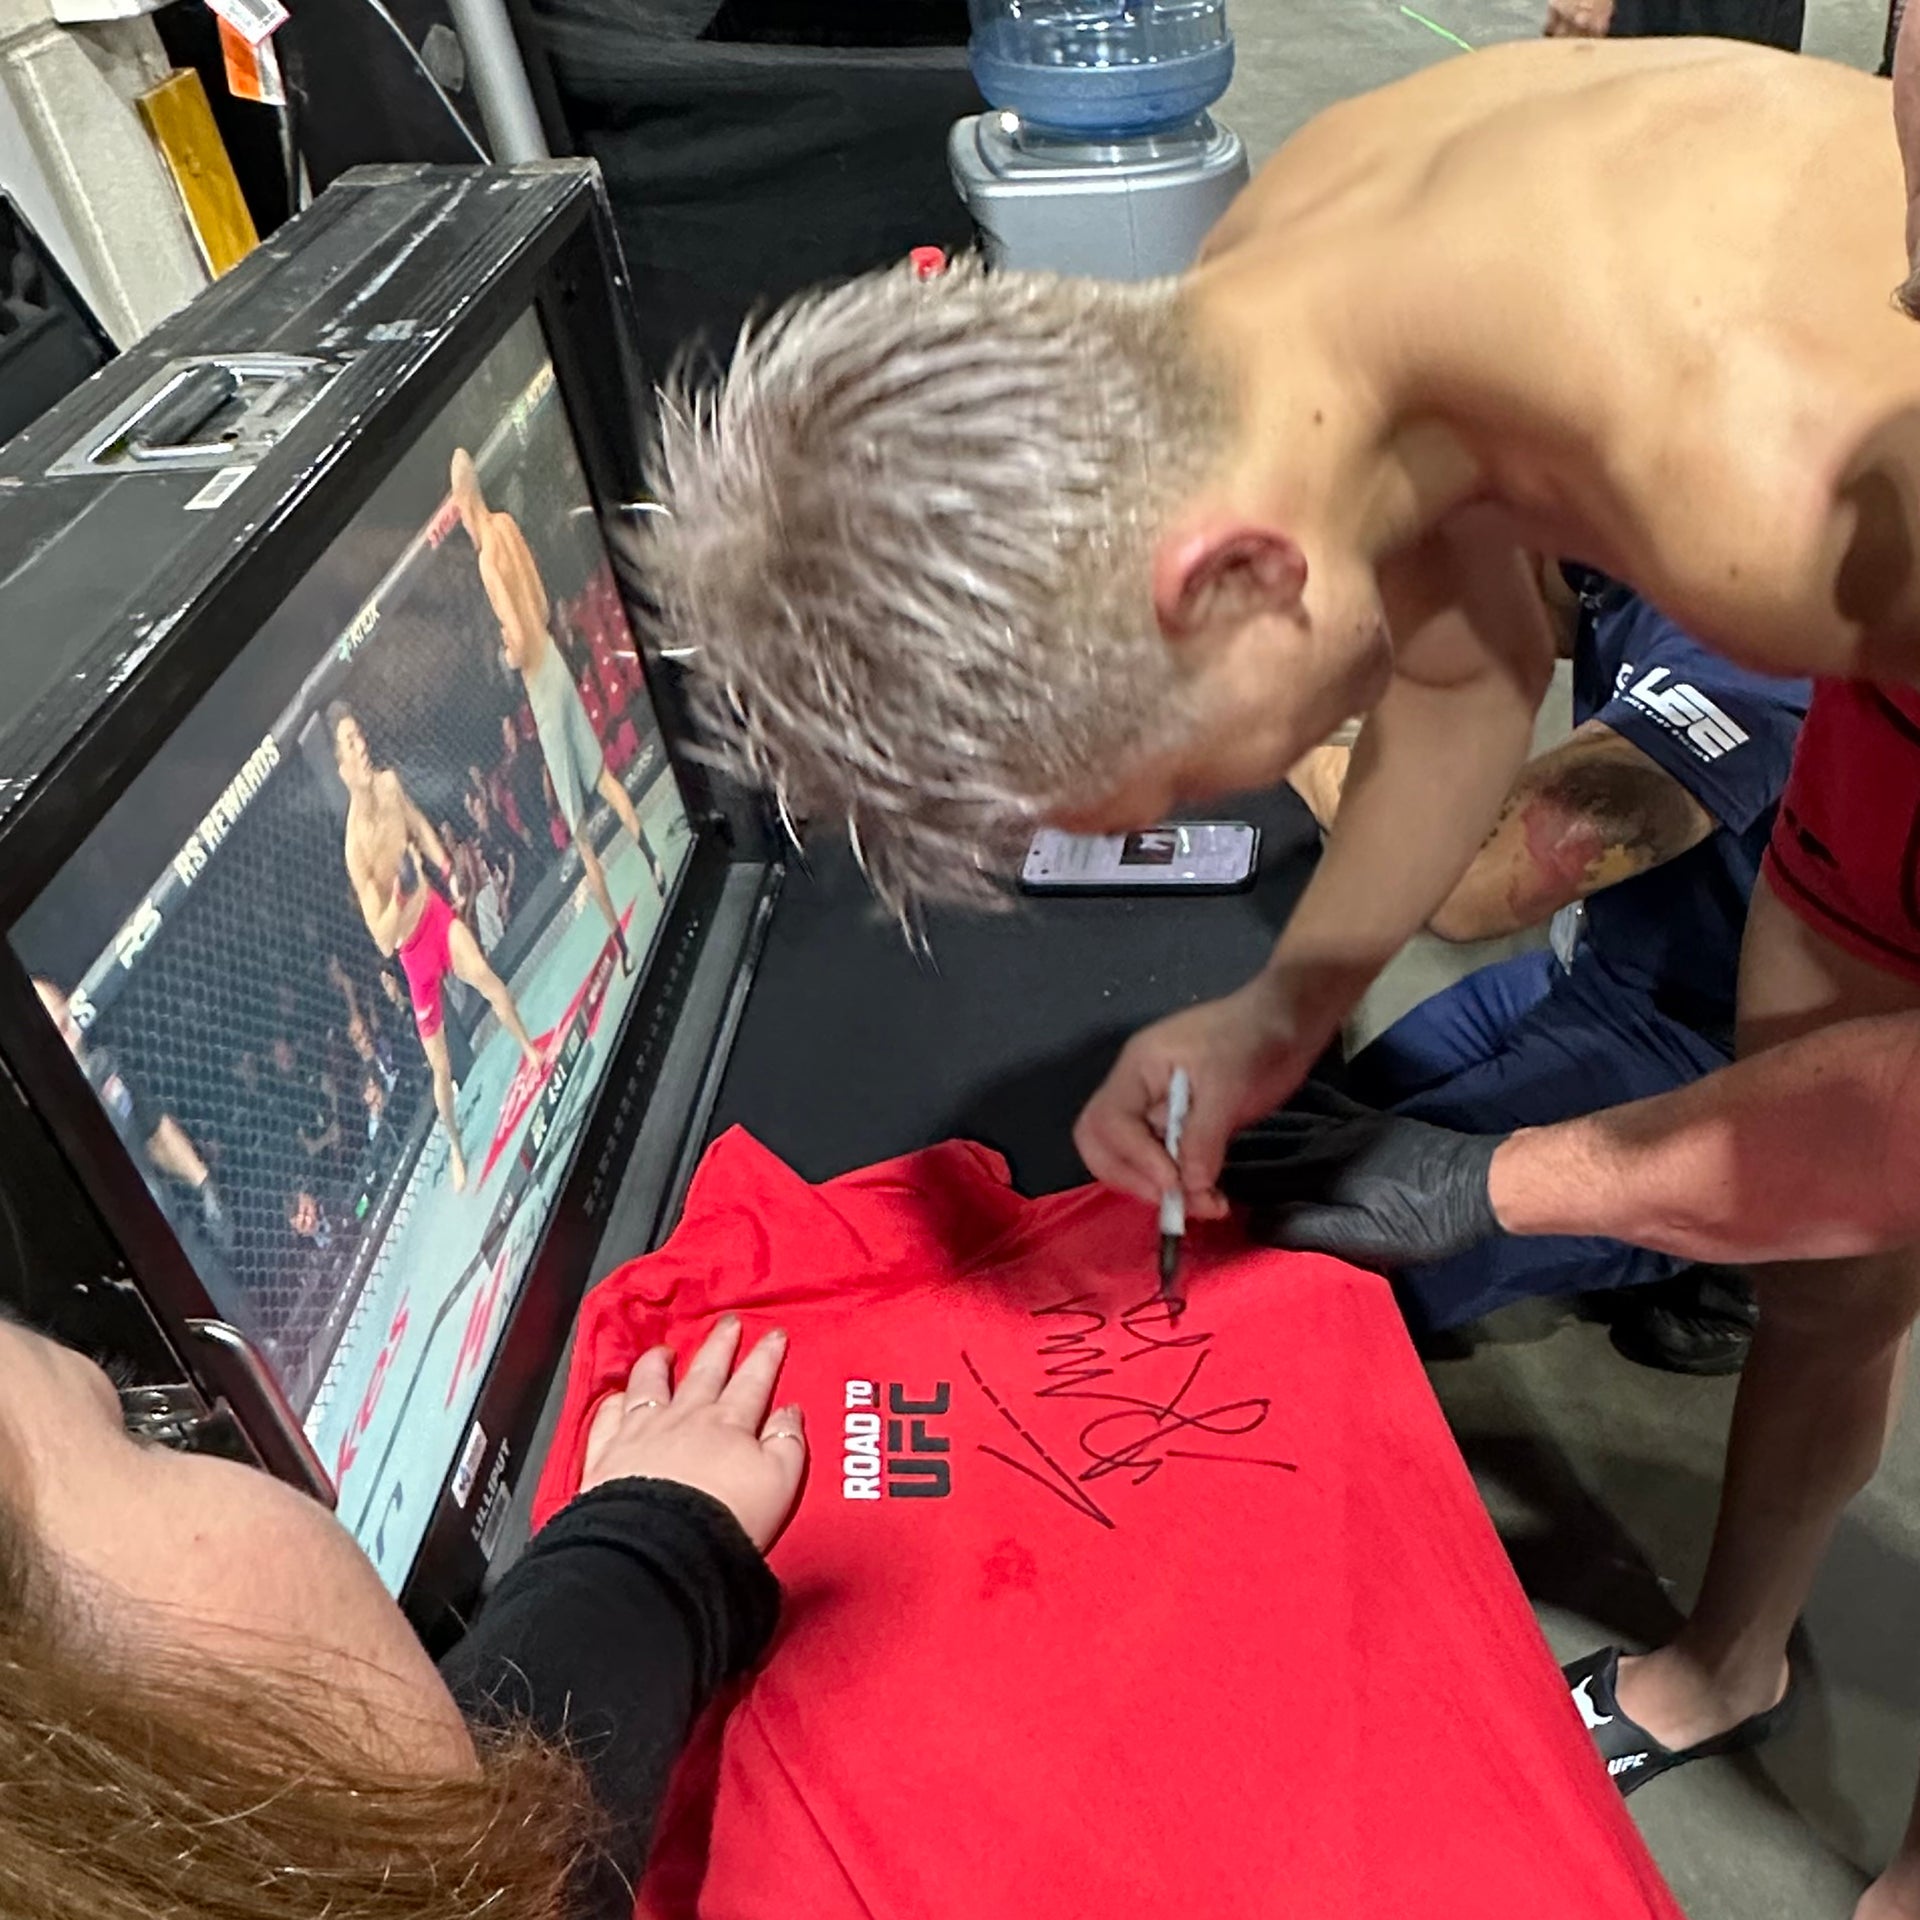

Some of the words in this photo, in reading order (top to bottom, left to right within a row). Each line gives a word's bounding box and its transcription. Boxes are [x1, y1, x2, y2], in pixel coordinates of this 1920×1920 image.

[198, 733, 281, 853] REWARDS
[845, 1380, 873, 1409] TO
[887, 1382, 951, 1498] UFC
[470, 1437, 511, 1542] LILLIPUT
[843, 1412, 881, 1499] ROAD
[1607, 1752, 1649, 1777] UFC
